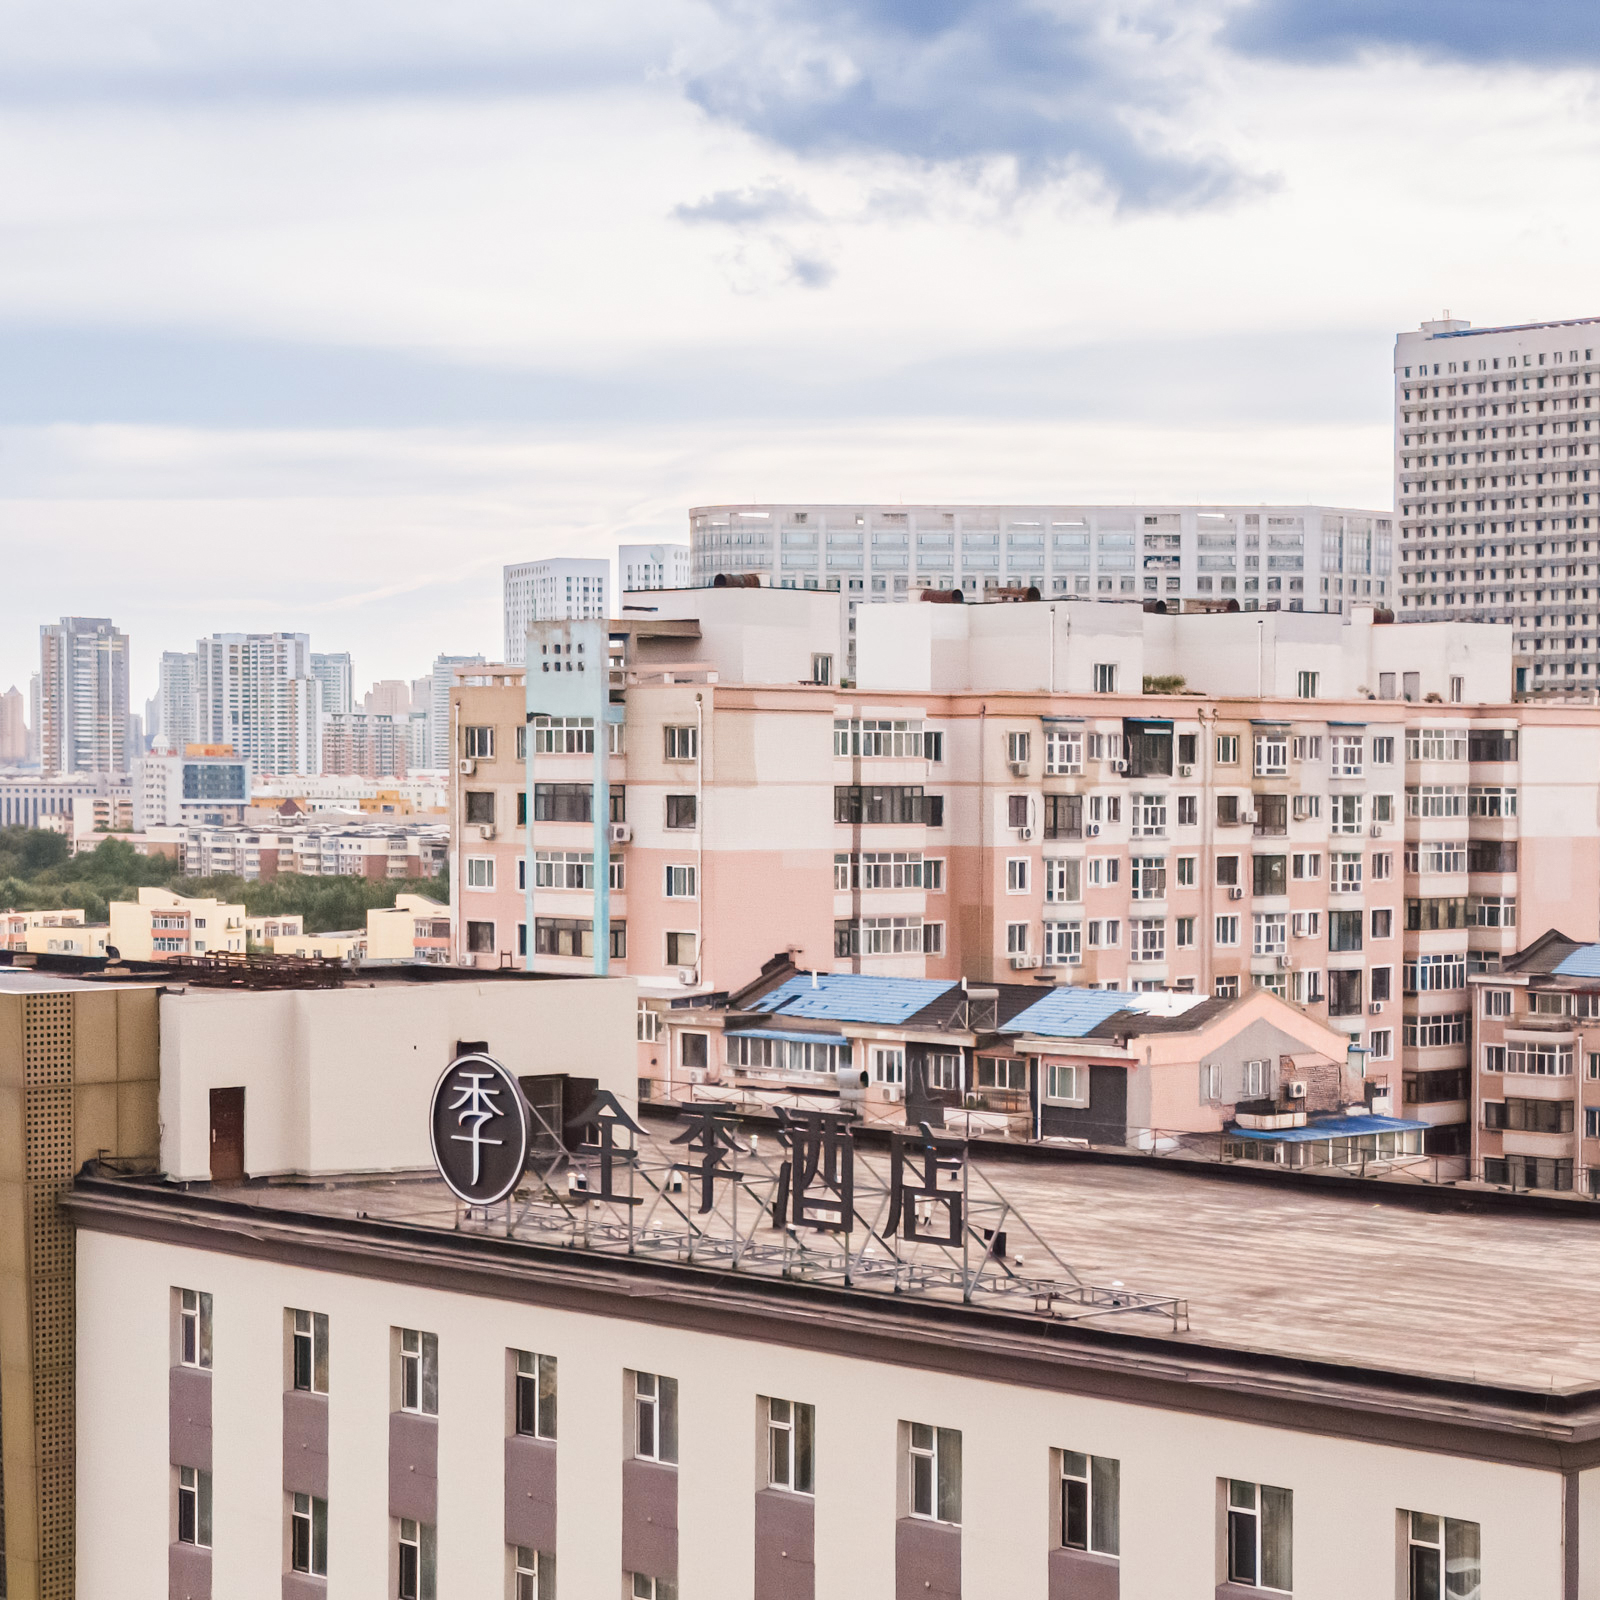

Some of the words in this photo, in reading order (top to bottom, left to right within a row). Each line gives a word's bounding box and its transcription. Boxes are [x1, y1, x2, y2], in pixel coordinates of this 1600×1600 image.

[448, 1072, 504, 1186] 季
[566, 1089, 969, 1248] 全季酒店
